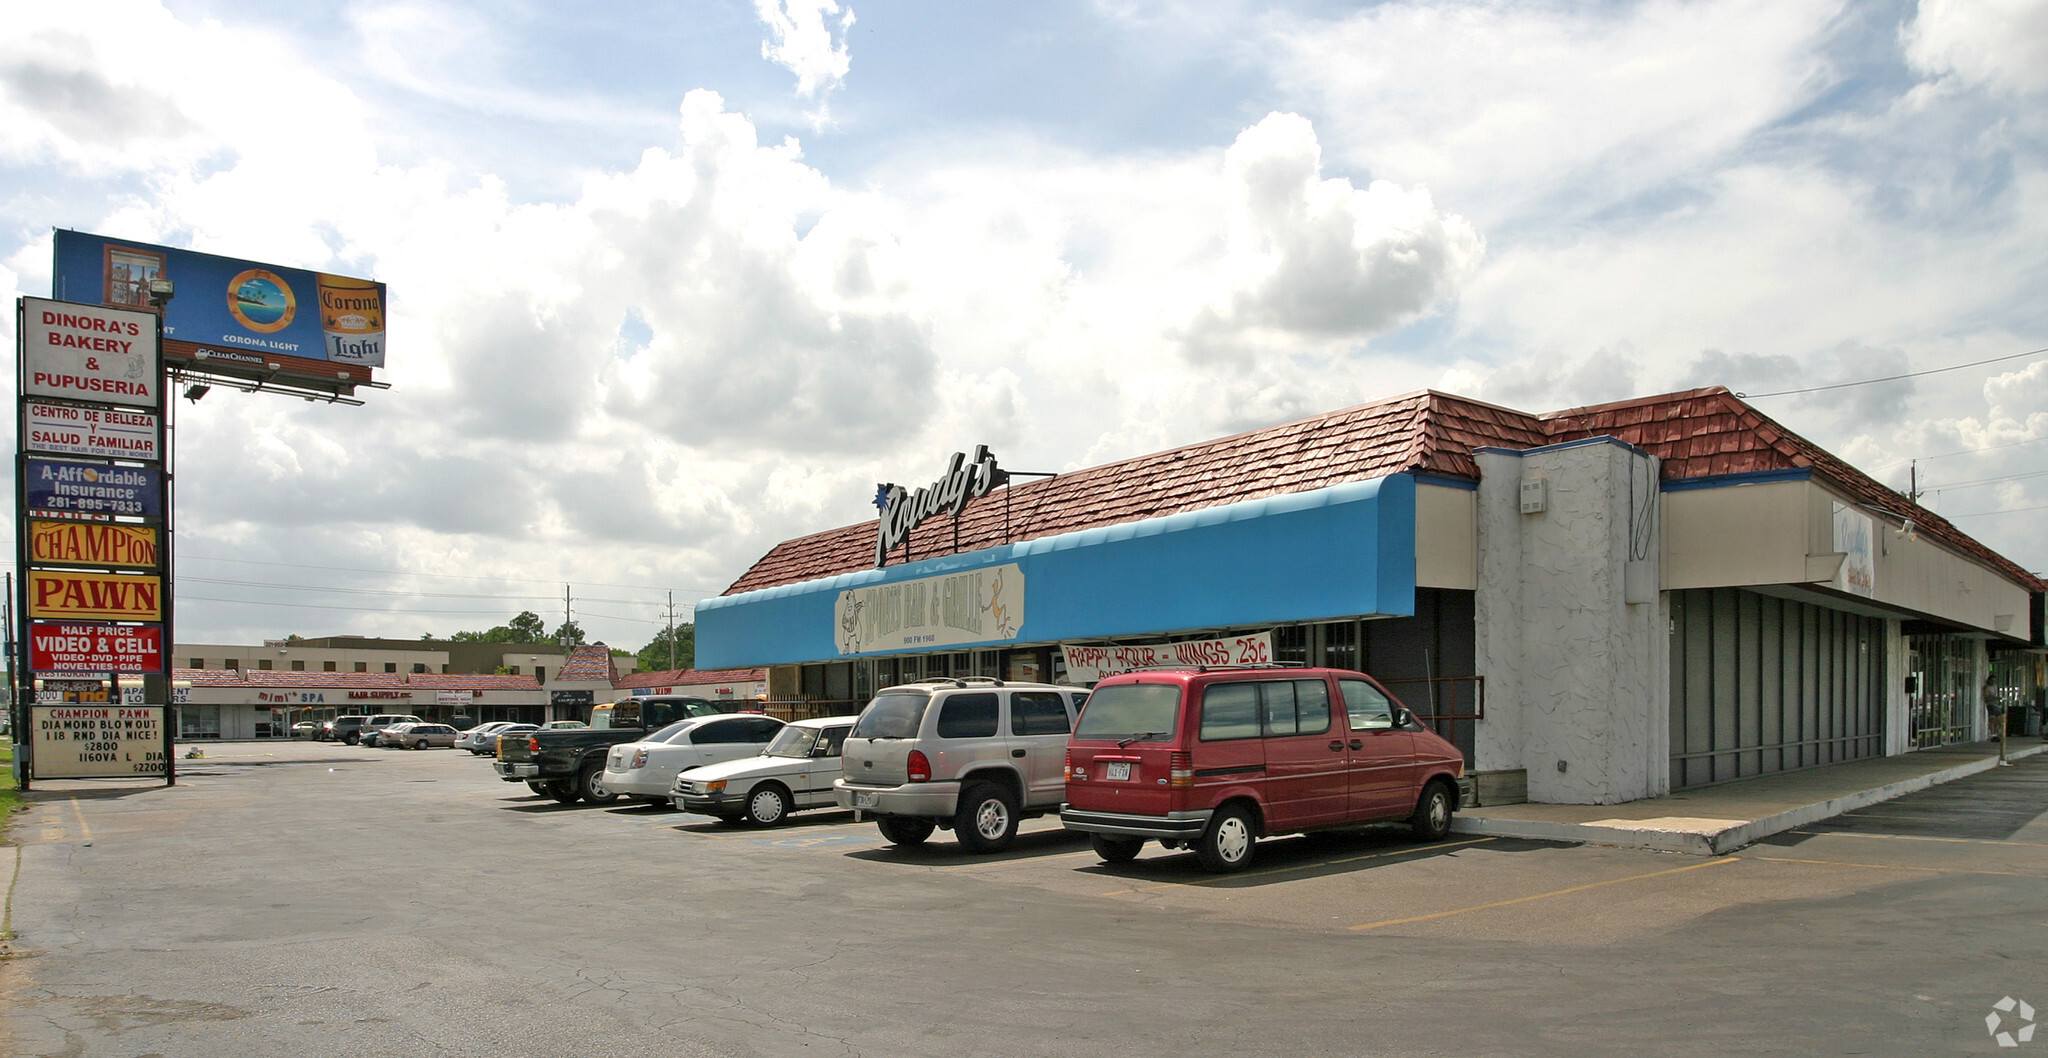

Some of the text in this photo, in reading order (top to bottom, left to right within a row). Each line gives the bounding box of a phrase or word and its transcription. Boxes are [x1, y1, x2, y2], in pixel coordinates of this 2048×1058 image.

[323, 290, 380, 312] Corona
[42, 311, 139, 336] DINORA'S
[48, 332, 132, 354] BAKERY
[222, 334, 299, 352] CORONA LIGHT
[332, 336, 380, 359] Light
[85, 357, 100, 371] &
[34, 372, 149, 396] PUPUSERIA
[32, 405, 154, 427] CENTRO DE BELLEZA
[90, 423, 97, 434] Y
[32, 430, 153, 451] SALUD FAMILIAR
[32, 442, 46, 450] THE
[54, 481, 134, 499] Insurance
[48, 496, 142, 512] 281-895-7333
[874, 444, 998, 568] Rowdy's
[34, 524, 156, 564] CHAMPION
[35, 578, 157, 611] PAWN
[865, 572, 983, 646] SPORTS BAR & GRILLE
[61, 626, 134, 636] HALF PRICE
[904, 636, 913, 645] 900
[914, 635, 922, 644] FM
[35, 636, 158, 654] VIDEO & CELL
[1066, 646, 1113, 669] HAPPY
[1116, 646, 1160, 668] HOUR
[1174, 641, 1230, 666] WINGS
[301, 693, 324, 702] SPA
[348, 691, 368, 699] HAIR
[370, 691, 400, 699] SUPPLY
[50, 709, 150, 718] CHAMPION PAWN
[42, 720, 96, 730] DIAMOND
[74, 731, 96, 740] RND
[102, 731, 120, 740] DIA
[126, 730, 158, 740] NICE!
[84, 742, 118, 751] $2800
[146, 752, 164, 761] DIA
[133, 762, 165, 772] $2200
